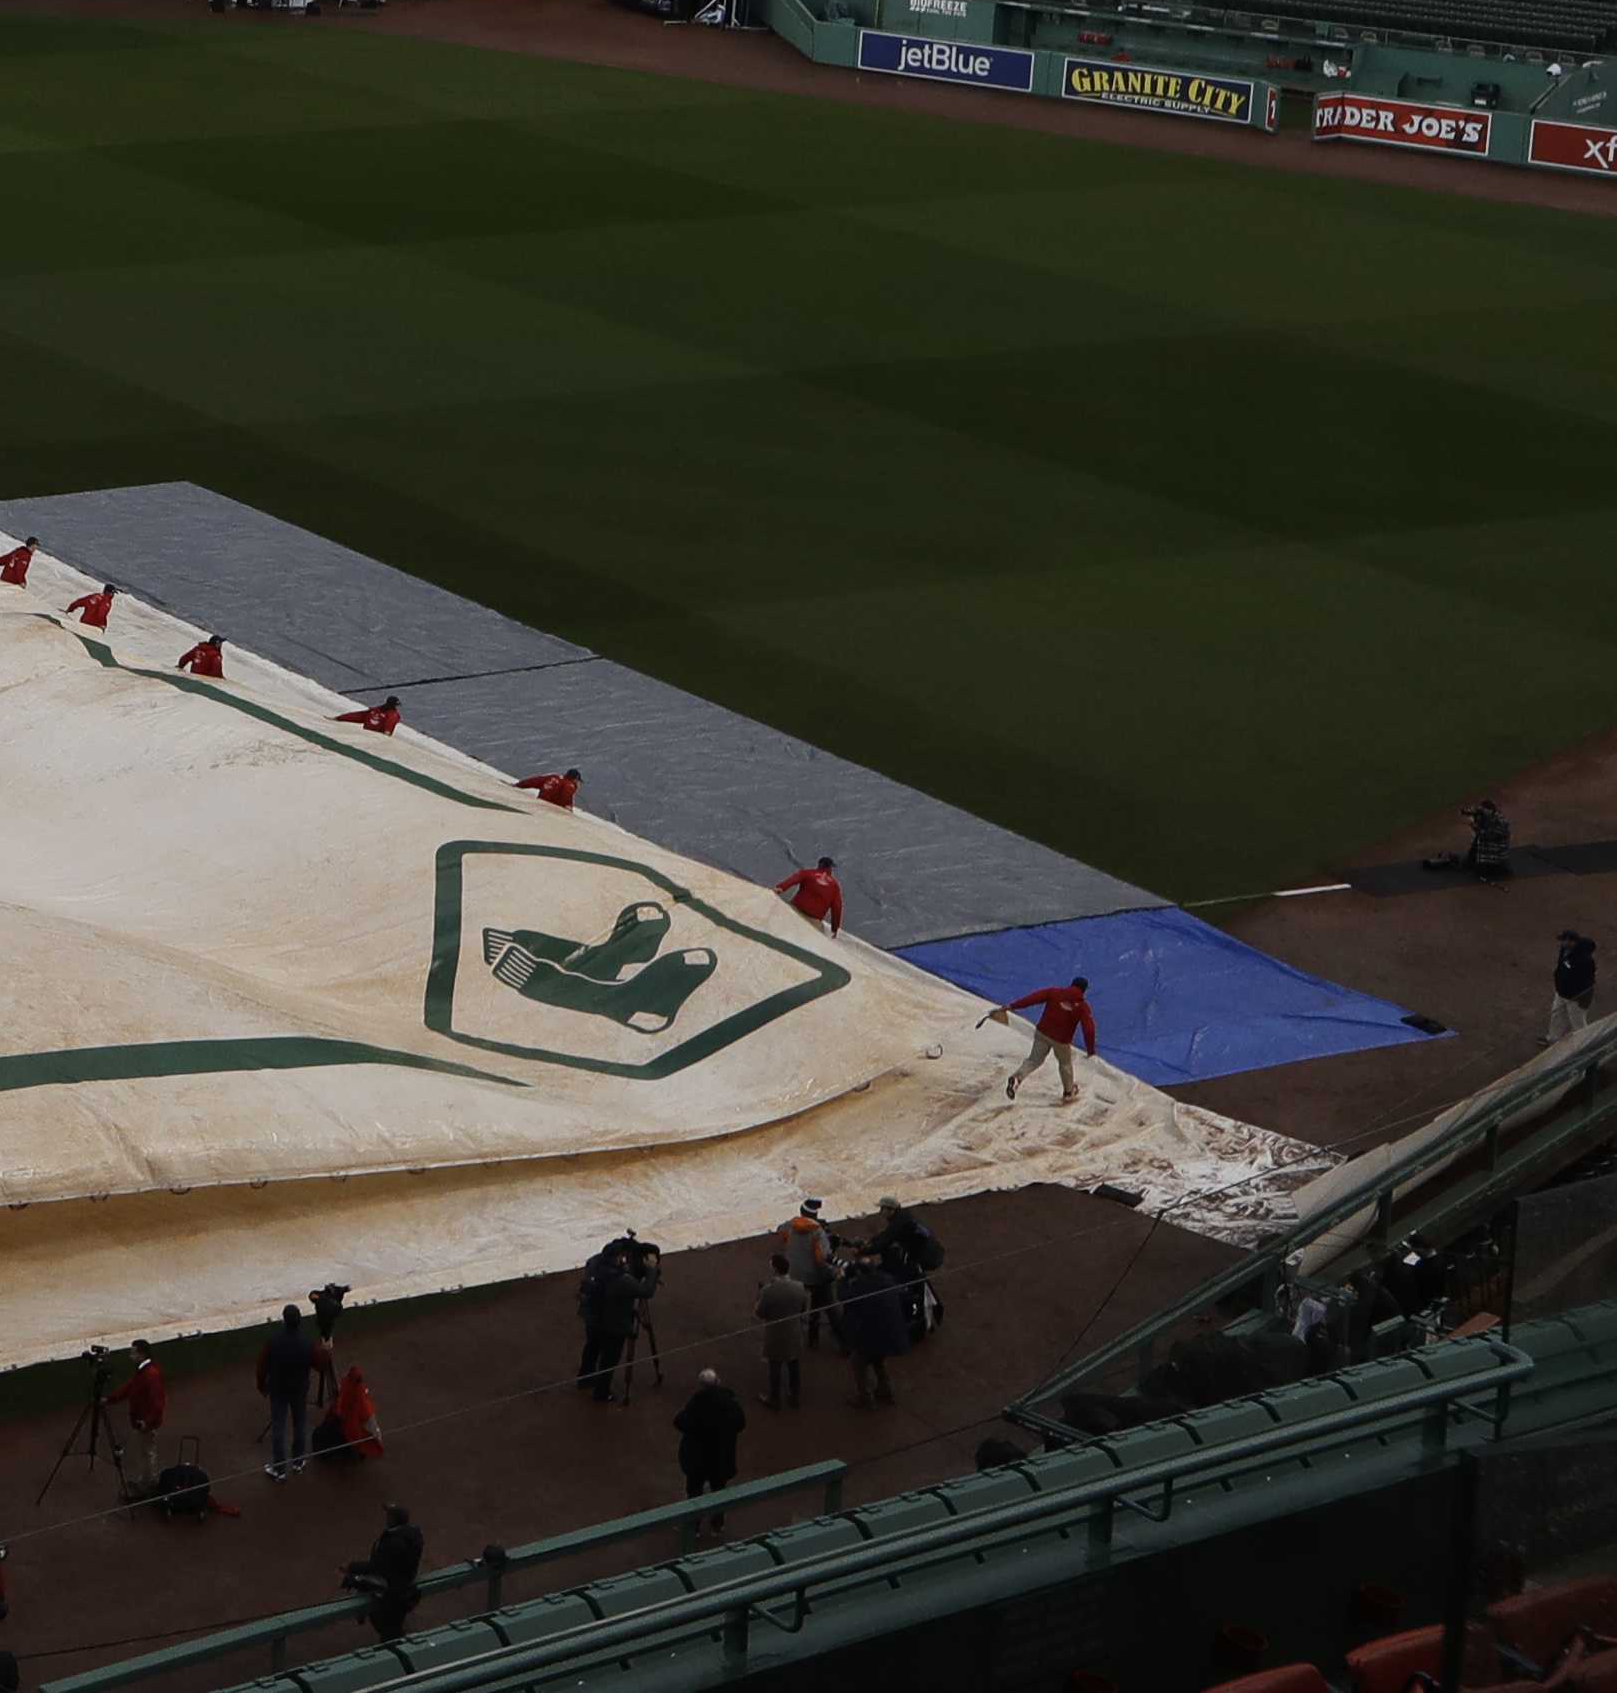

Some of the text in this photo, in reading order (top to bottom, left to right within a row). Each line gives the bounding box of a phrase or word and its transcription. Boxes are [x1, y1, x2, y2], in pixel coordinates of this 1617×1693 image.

[898, 40, 991, 76] jetBlue
[1071, 67, 1182, 98] GRANITE
[1188, 77, 1246, 116] CITY
[1101, 93, 1211, 113] ELECTRIC SUPPLY
[1403, 114, 1483, 143] JOE'S
